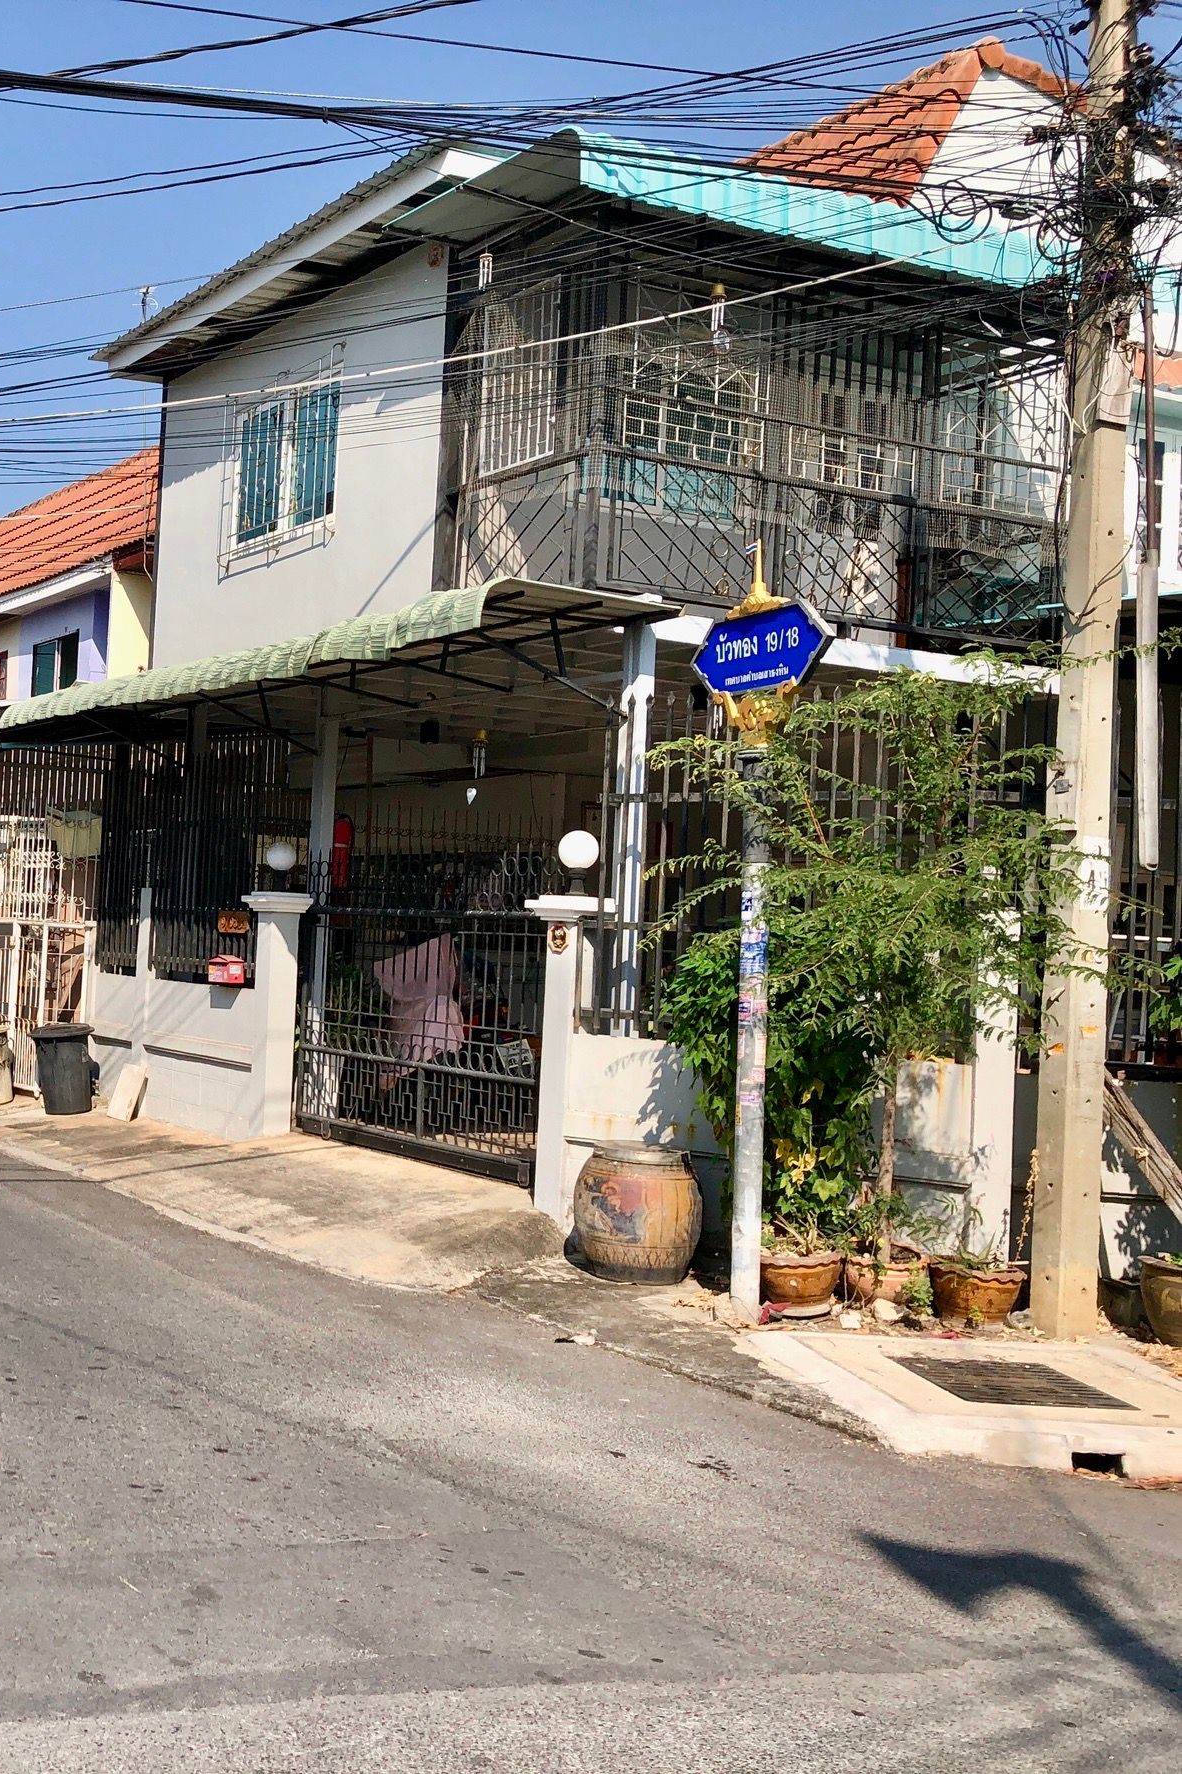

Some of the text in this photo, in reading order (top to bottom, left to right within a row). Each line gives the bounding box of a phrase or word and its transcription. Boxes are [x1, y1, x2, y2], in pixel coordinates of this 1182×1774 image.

[716, 626, 799, 664] บัวทอง 19/18
